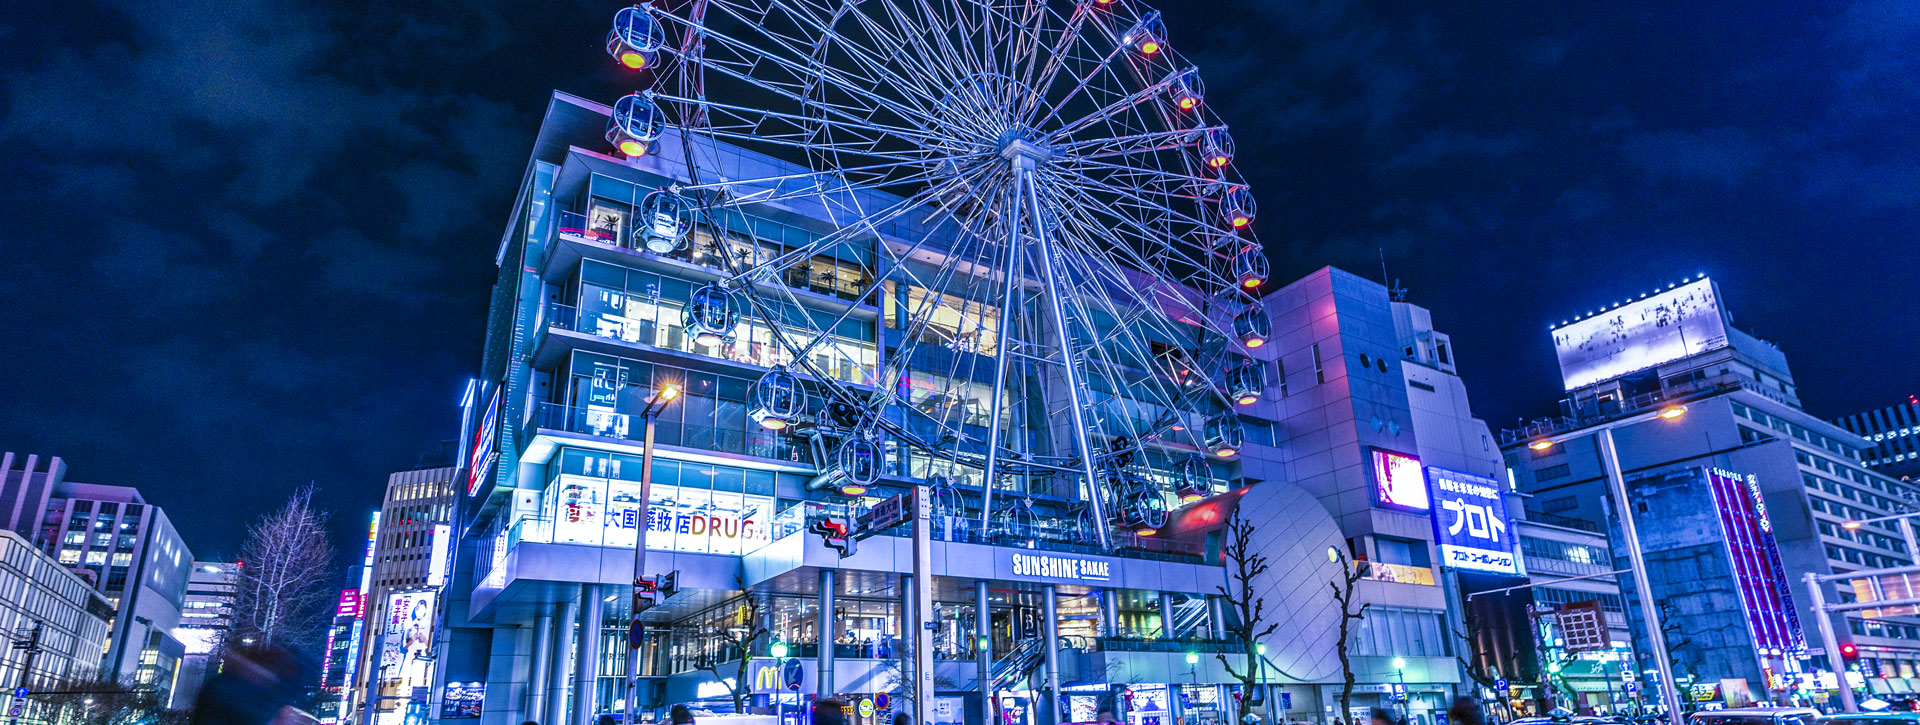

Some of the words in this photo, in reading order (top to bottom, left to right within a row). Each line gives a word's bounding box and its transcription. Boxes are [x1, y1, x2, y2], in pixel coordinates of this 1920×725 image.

[1442, 497, 1506, 543] プロト
[1012, 553, 1079, 579] SUNSHINE
[1080, 559, 1110, 577] SAKAE
[1452, 550, 1469, 561] プロト
